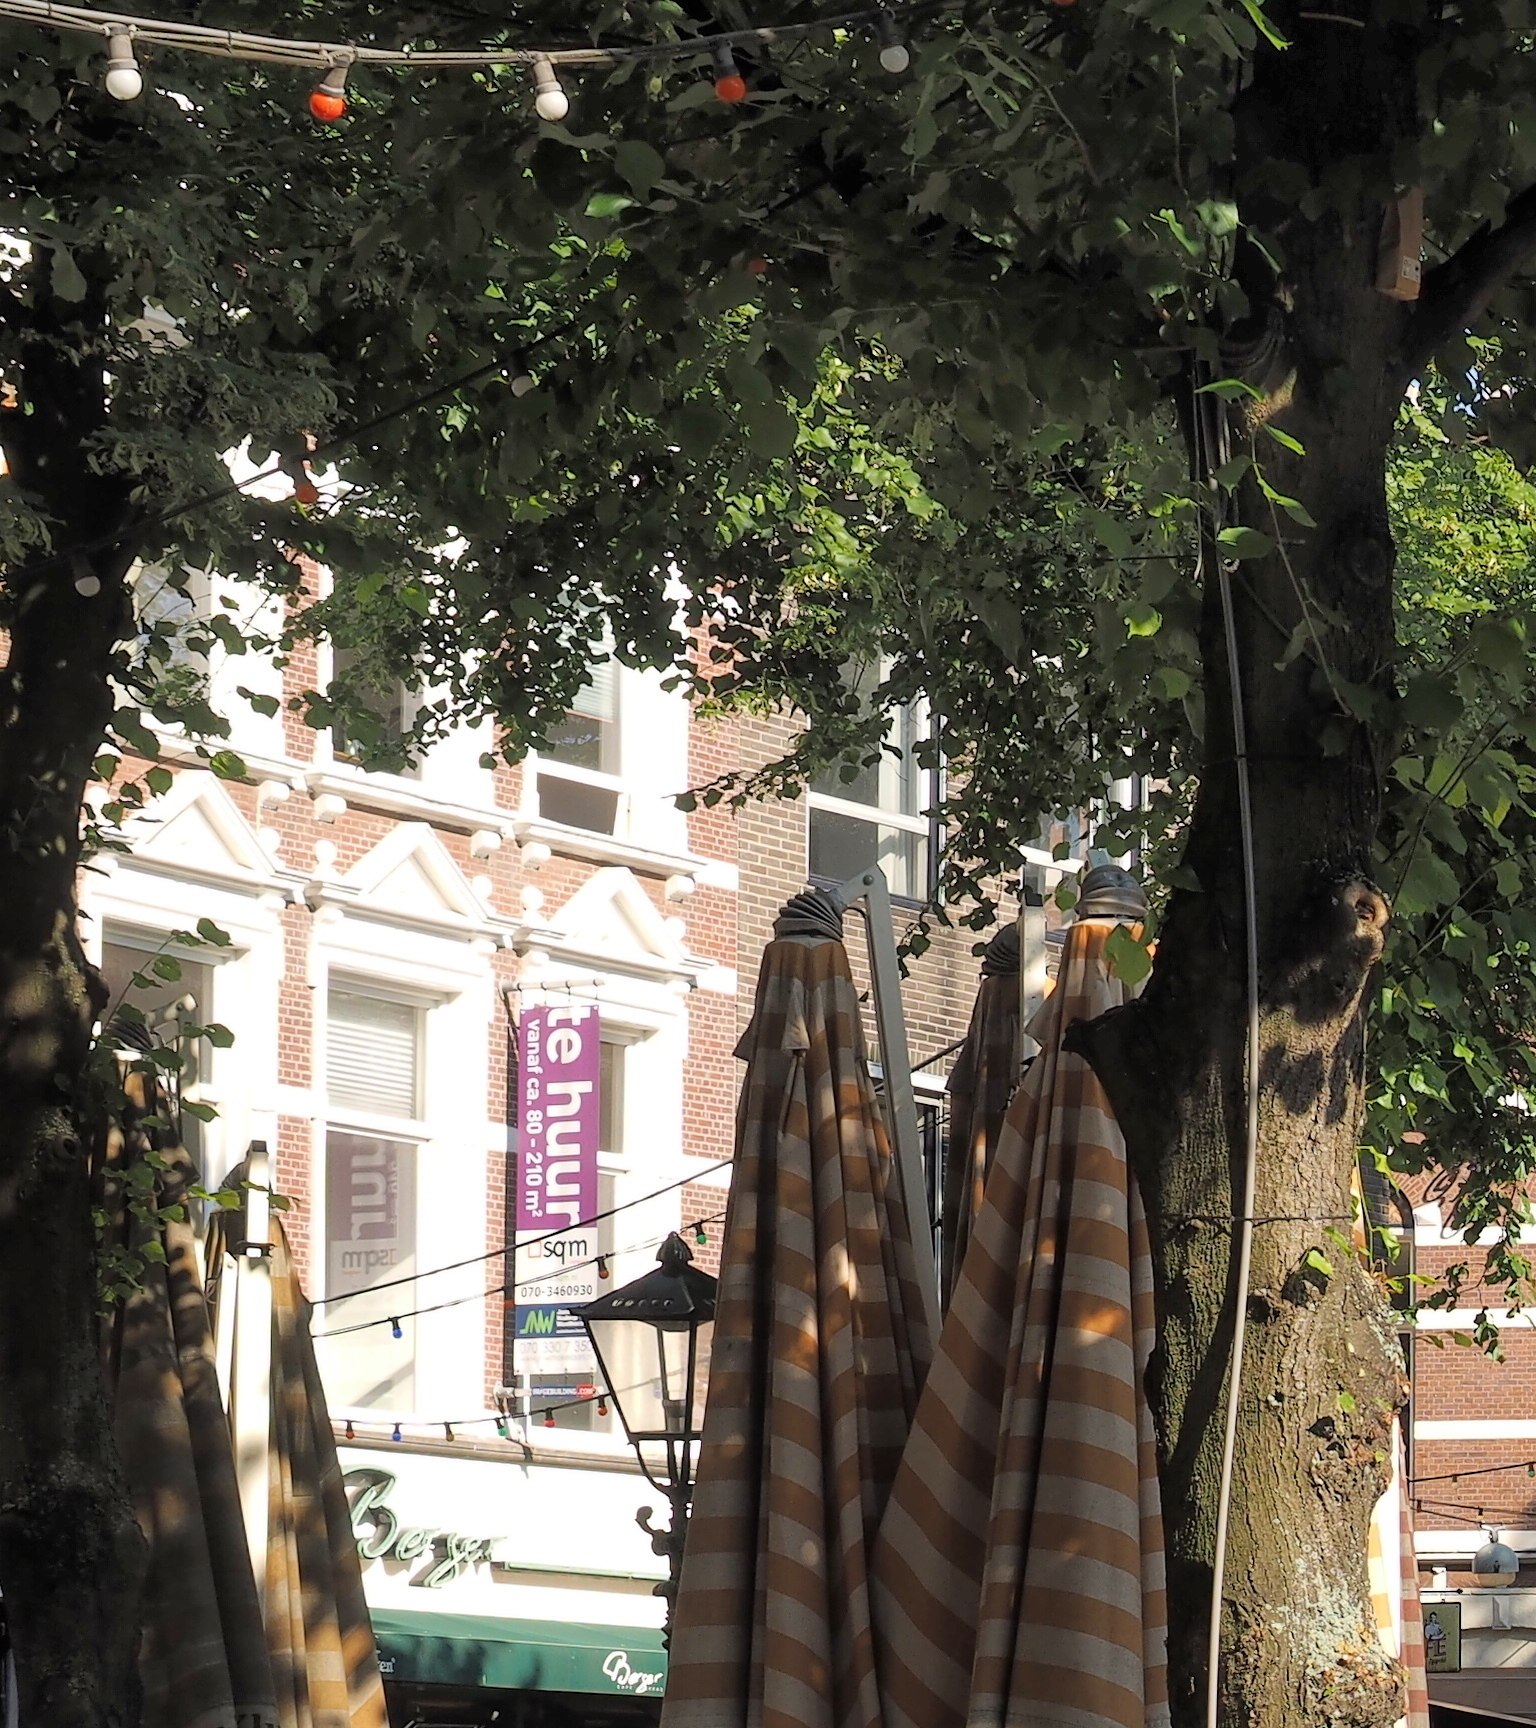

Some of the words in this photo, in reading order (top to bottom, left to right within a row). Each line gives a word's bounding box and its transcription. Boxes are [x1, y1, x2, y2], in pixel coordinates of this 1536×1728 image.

[526, 1018, 544, 1075] vanaf
[546, 1004, 592, 1065] te
[526, 1077, 541, 1106] ca.
[525, 1109, 544, 1135] 80
[525, 1151, 543, 1187] 210
[545, 1080, 593, 1228] huur
[520, 1284, 594, 1298] 070-3460930
[602, 1650, 664, 1694] Berger
